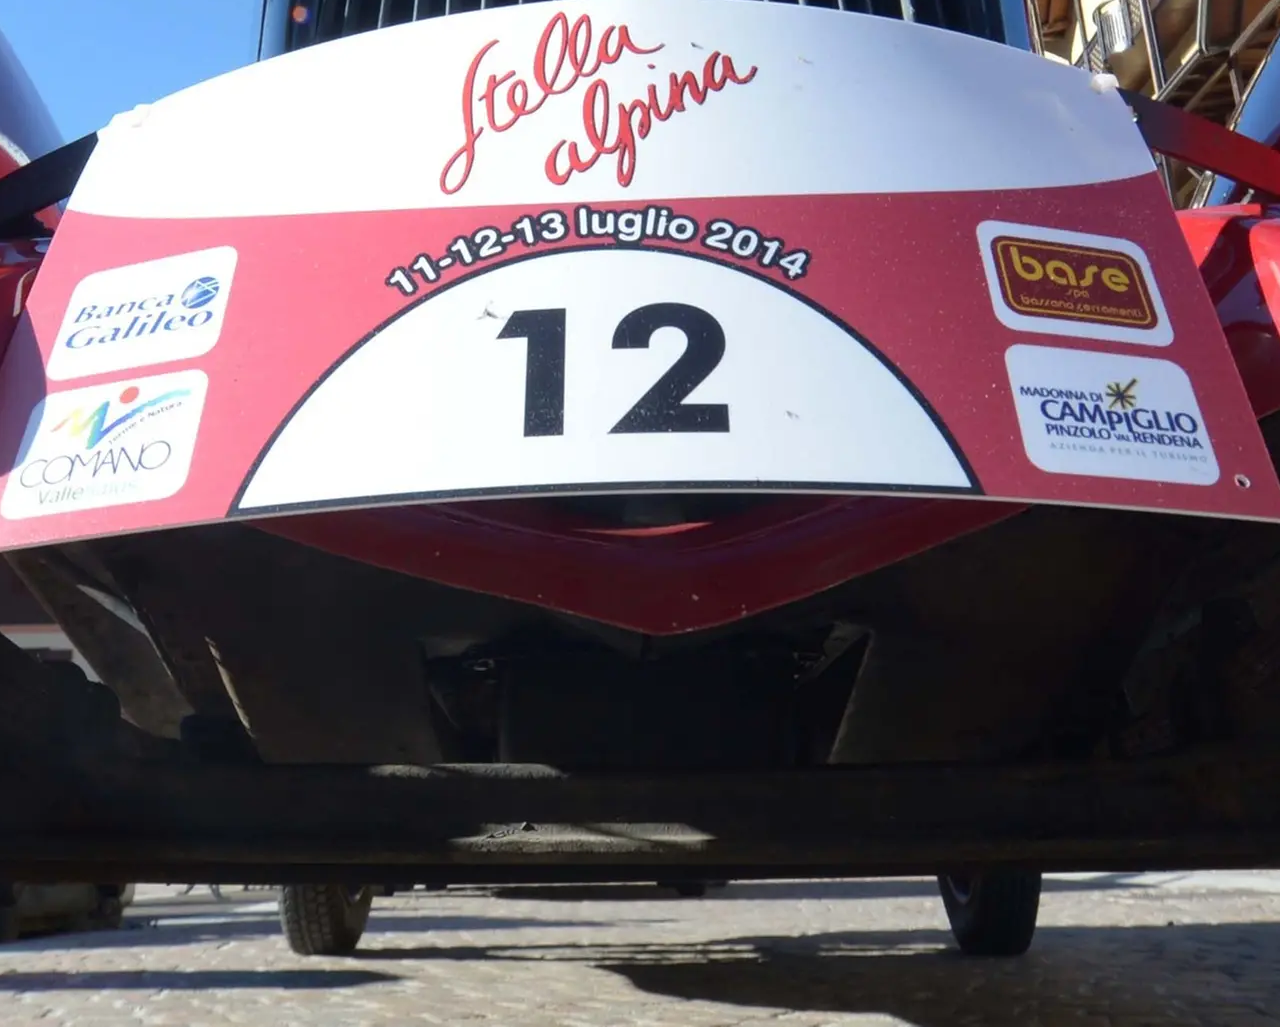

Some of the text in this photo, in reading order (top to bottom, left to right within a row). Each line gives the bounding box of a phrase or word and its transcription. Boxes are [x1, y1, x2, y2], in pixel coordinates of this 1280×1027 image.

[440, 11, 665, 194] Stella
[545, 51, 758, 187] alpina
[388, 207, 809, 295] 11-12-13 luglio 2014
[1010, 245, 1130, 292] base
[65, 310, 213, 349] Galileo
[74, 293, 174, 323] Banca
[495, 301, 731, 438] 12
[1020, 386, 1104, 403] MADONNA DI
[1040, 399, 1198, 434] CAMPIGLIO
[1045, 423, 1111, 441] PINZOLO
[1132, 431, 1204, 450] RENDENA
[20, 440, 172, 488] COMANO
[1050, 442, 1106, 454] AZIENDA
[1110, 447, 1133, 457] PER
[1153, 452, 1209, 464] TURISMO
